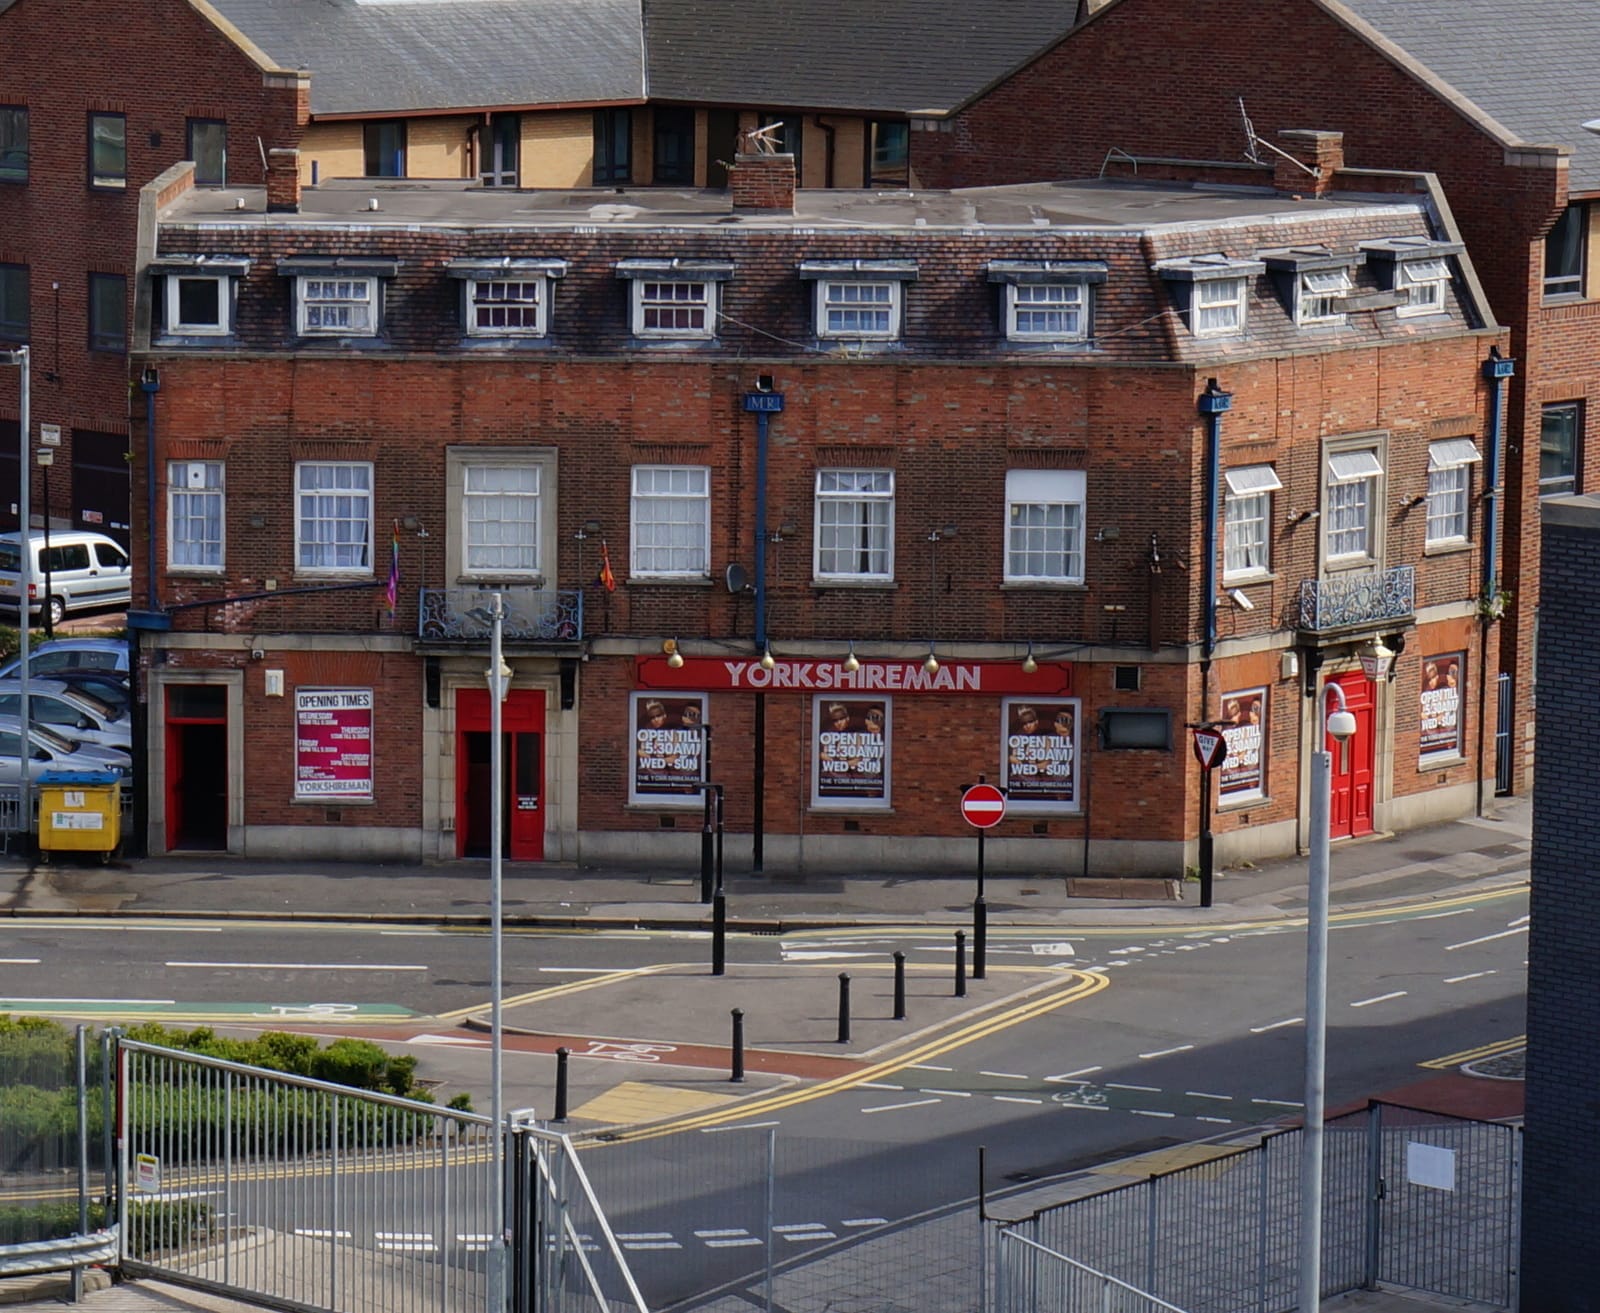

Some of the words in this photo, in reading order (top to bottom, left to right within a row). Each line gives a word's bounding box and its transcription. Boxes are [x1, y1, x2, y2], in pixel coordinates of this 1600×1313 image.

[724, 662, 981, 690] YORKSHIREMAN
[299, 695, 339, 708] OPENING
[341, 694, 369, 706] TIMES
[1420, 690, 1440, 704] OPEN
[1443, 687, 1458, 699] TILL
[1246, 725, 1260, 737] TILL
[1421, 718, 1438, 731] WED
[637, 729, 673, 742] OPEN
[677, 730, 700, 742] TILL
[820, 732, 857, 744] OPEN
[860, 732, 884, 745] TILL
[1008, 735, 1046, 748] OPEN
[1049, 735, 1073, 748] TILL
[1198, 735, 1215, 746] GIVE
[639, 757, 666, 769] WED
[674, 757, 698, 770] SUN
[822, 760, 849, 772] WED
[857, 761, 881, 773] SUN
[1011, 763, 1037, 775] WED
[1046, 764, 1070, 776] SUN
[1222, 756, 1239, 771] WED
[299, 780, 370, 792] YORKSHIREMAN
